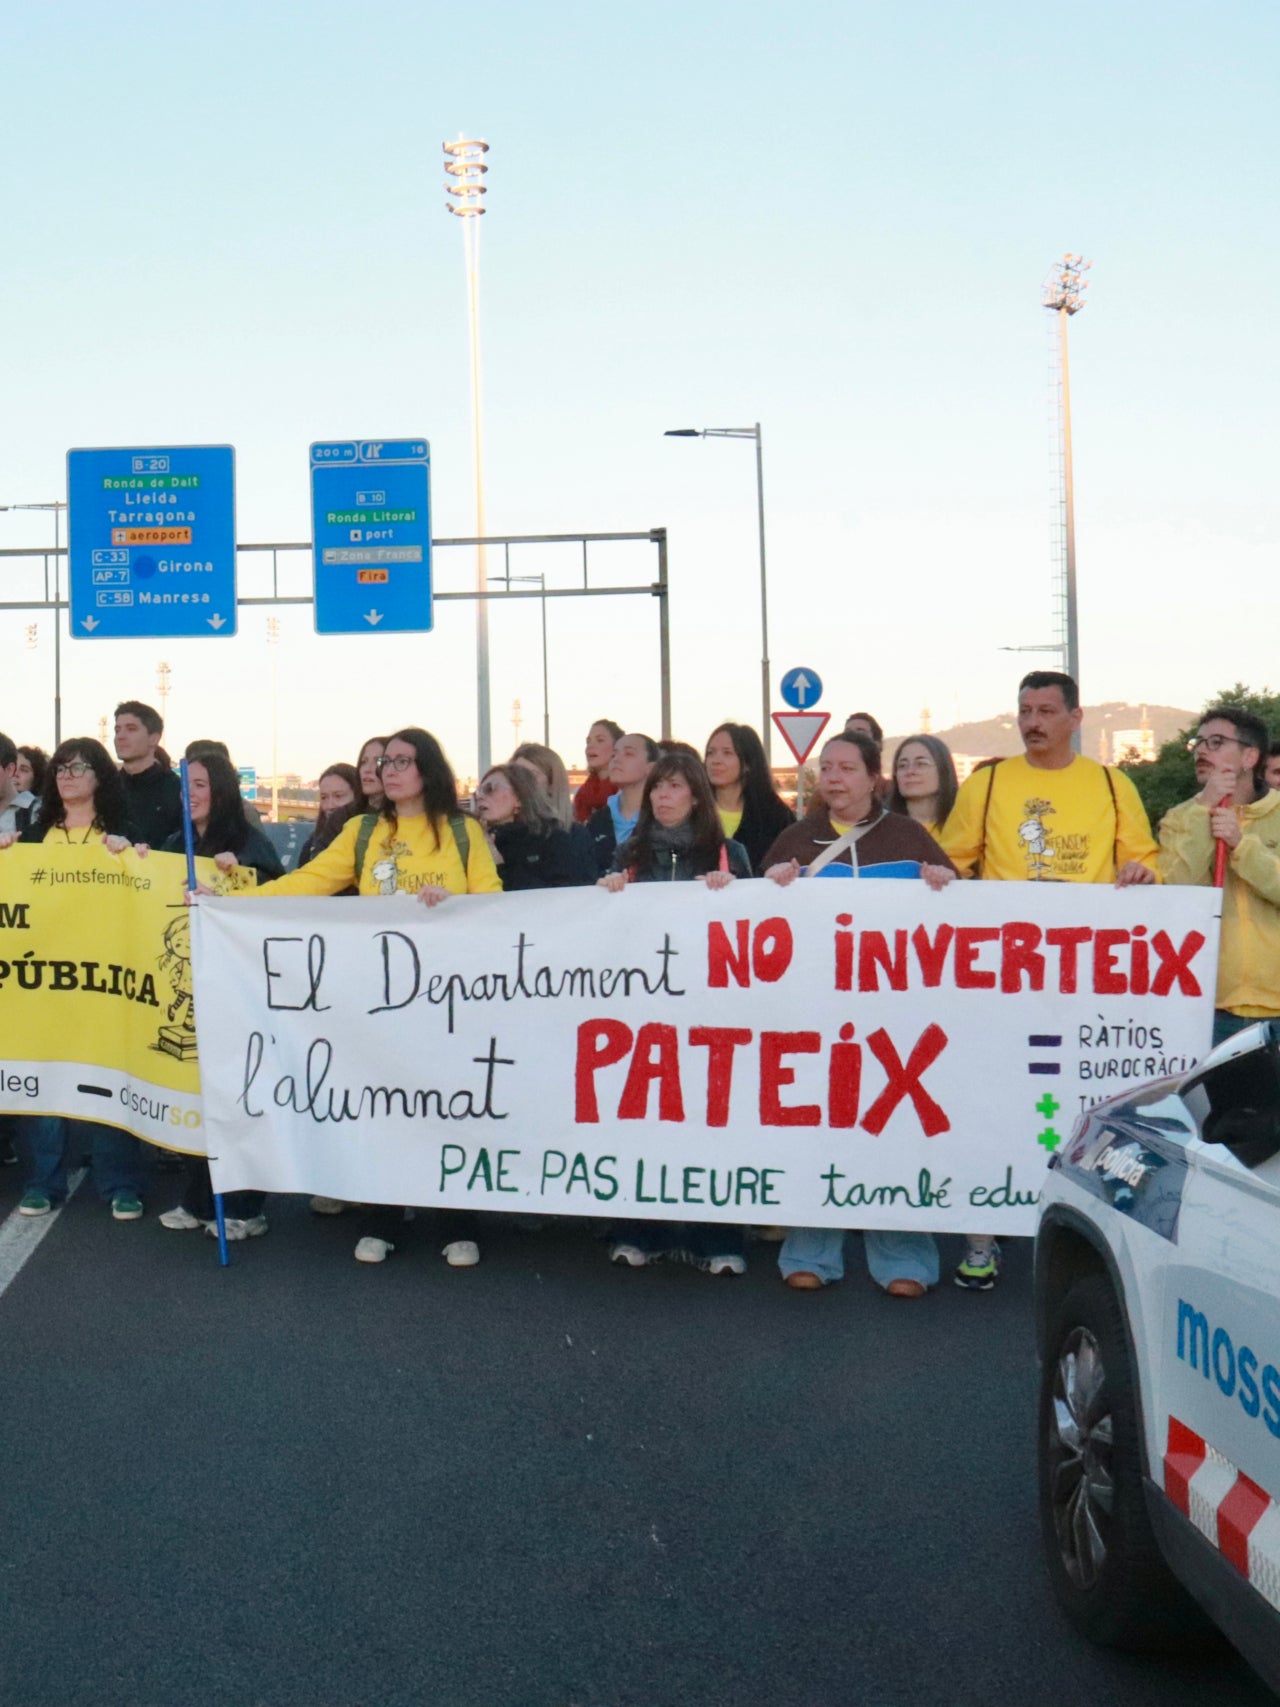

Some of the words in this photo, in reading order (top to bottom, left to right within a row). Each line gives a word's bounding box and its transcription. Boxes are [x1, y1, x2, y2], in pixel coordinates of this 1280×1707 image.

[315, 448, 340, 458] 200
[343, 449, 353, 457] m
[134, 459, 167, 471] B-20
[103, 478, 144, 489] Ronda
[150, 477, 165, 488] de
[171, 476, 199, 488] Dalt
[125, 492, 178, 506] Lleida
[108, 510, 196, 526] Tarragona
[326, 512, 367, 523] Ronda
[373, 511, 416, 522] Litoral
[129, 530, 190, 543] aeroport
[365, 528, 394, 541] port
[95, 551, 127, 563] C-33
[340, 550, 372, 561] Zona
[376, 549, 421, 560] Franca
[158, 559, 214, 573] Girona
[95, 571, 127, 582] AP-7
[359, 571, 387, 582] Fira
[98, 592, 131, 604] C-58
[138, 591, 211, 605] Manresa
[263, 933, 332, 1012] El
[367, 930, 686, 1034] Departament
[706, 917, 794, 989] NO
[236, 1031, 516, 1123] l'alumnat
[1090, 1145, 1146, 1188] policia
[635, 1158, 786, 1208] LLEURE
[820, 1162, 953, 1210] també
